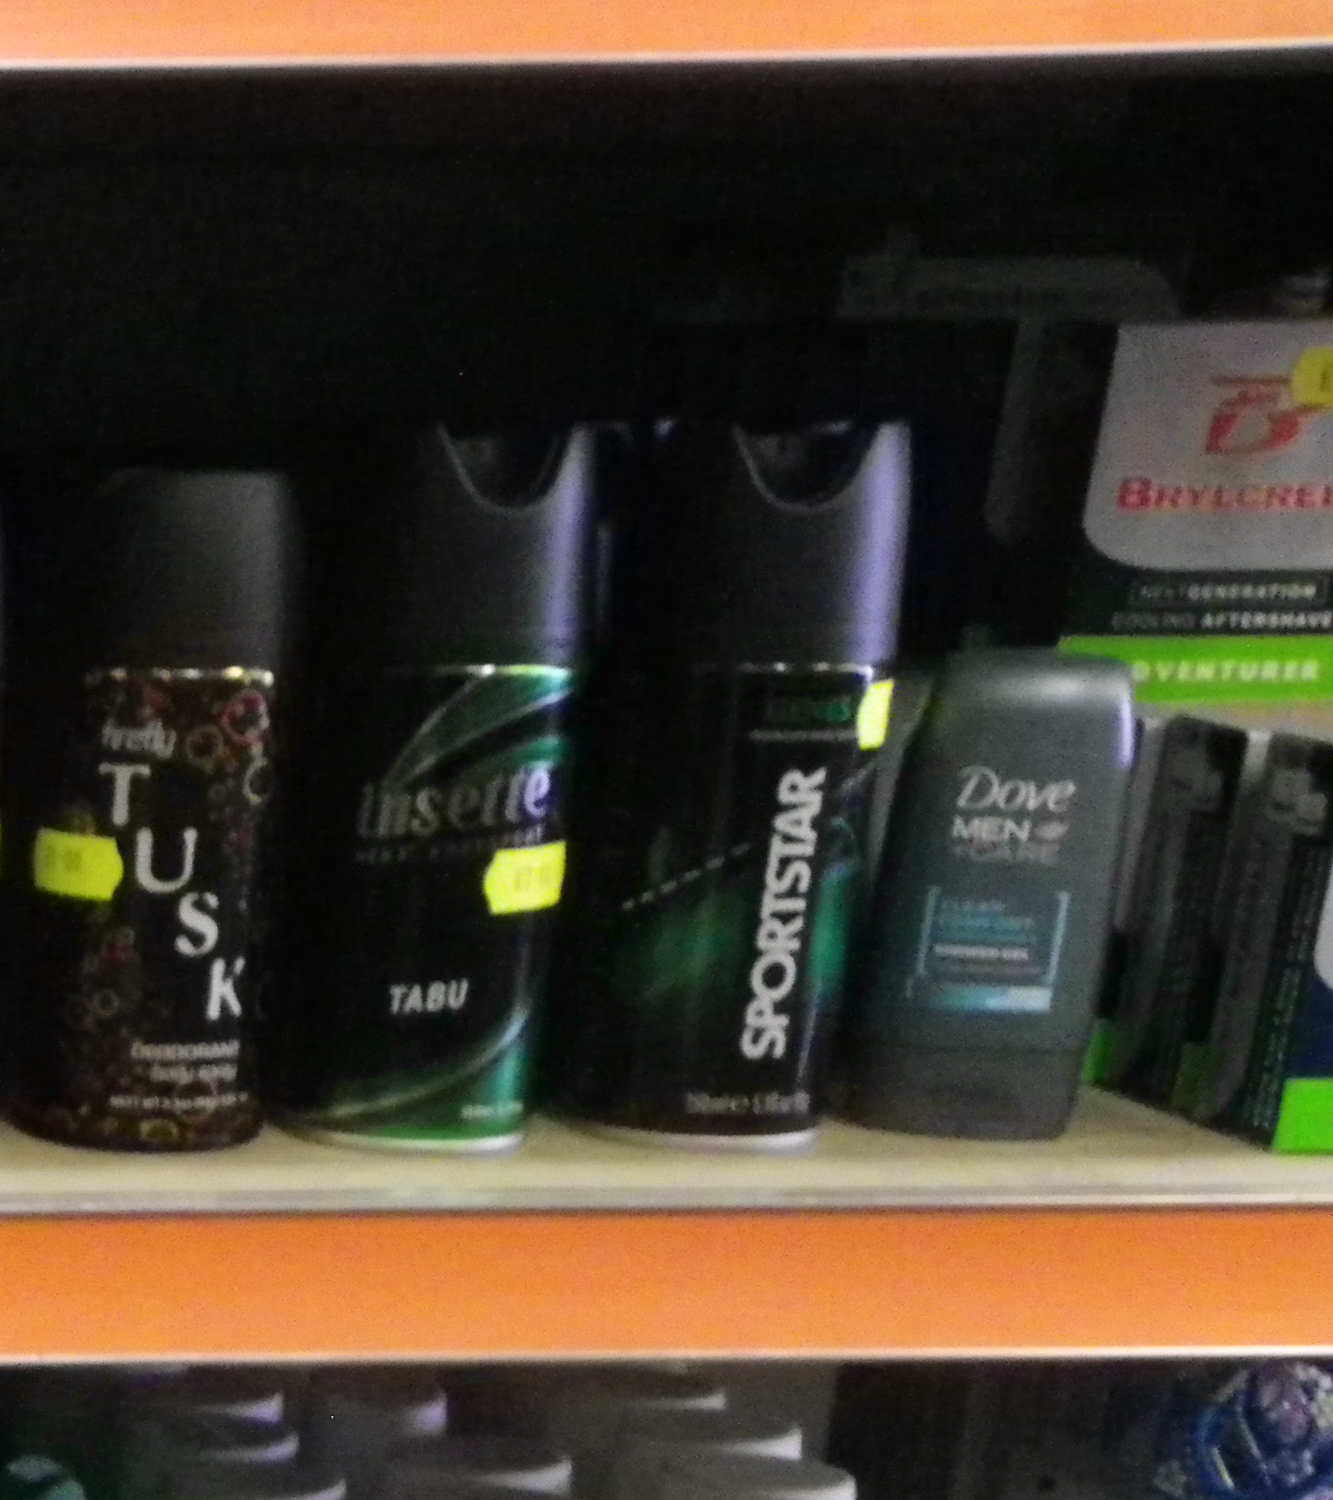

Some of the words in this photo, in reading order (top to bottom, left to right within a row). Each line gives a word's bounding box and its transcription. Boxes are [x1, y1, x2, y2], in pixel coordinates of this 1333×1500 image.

[1133, 659, 1321, 684] DVENTURER
[956, 764, 1077, 813] Dove
[739, 766, 828, 1060] SPORTSTAR
[389, 977, 470, 1016] TABU
